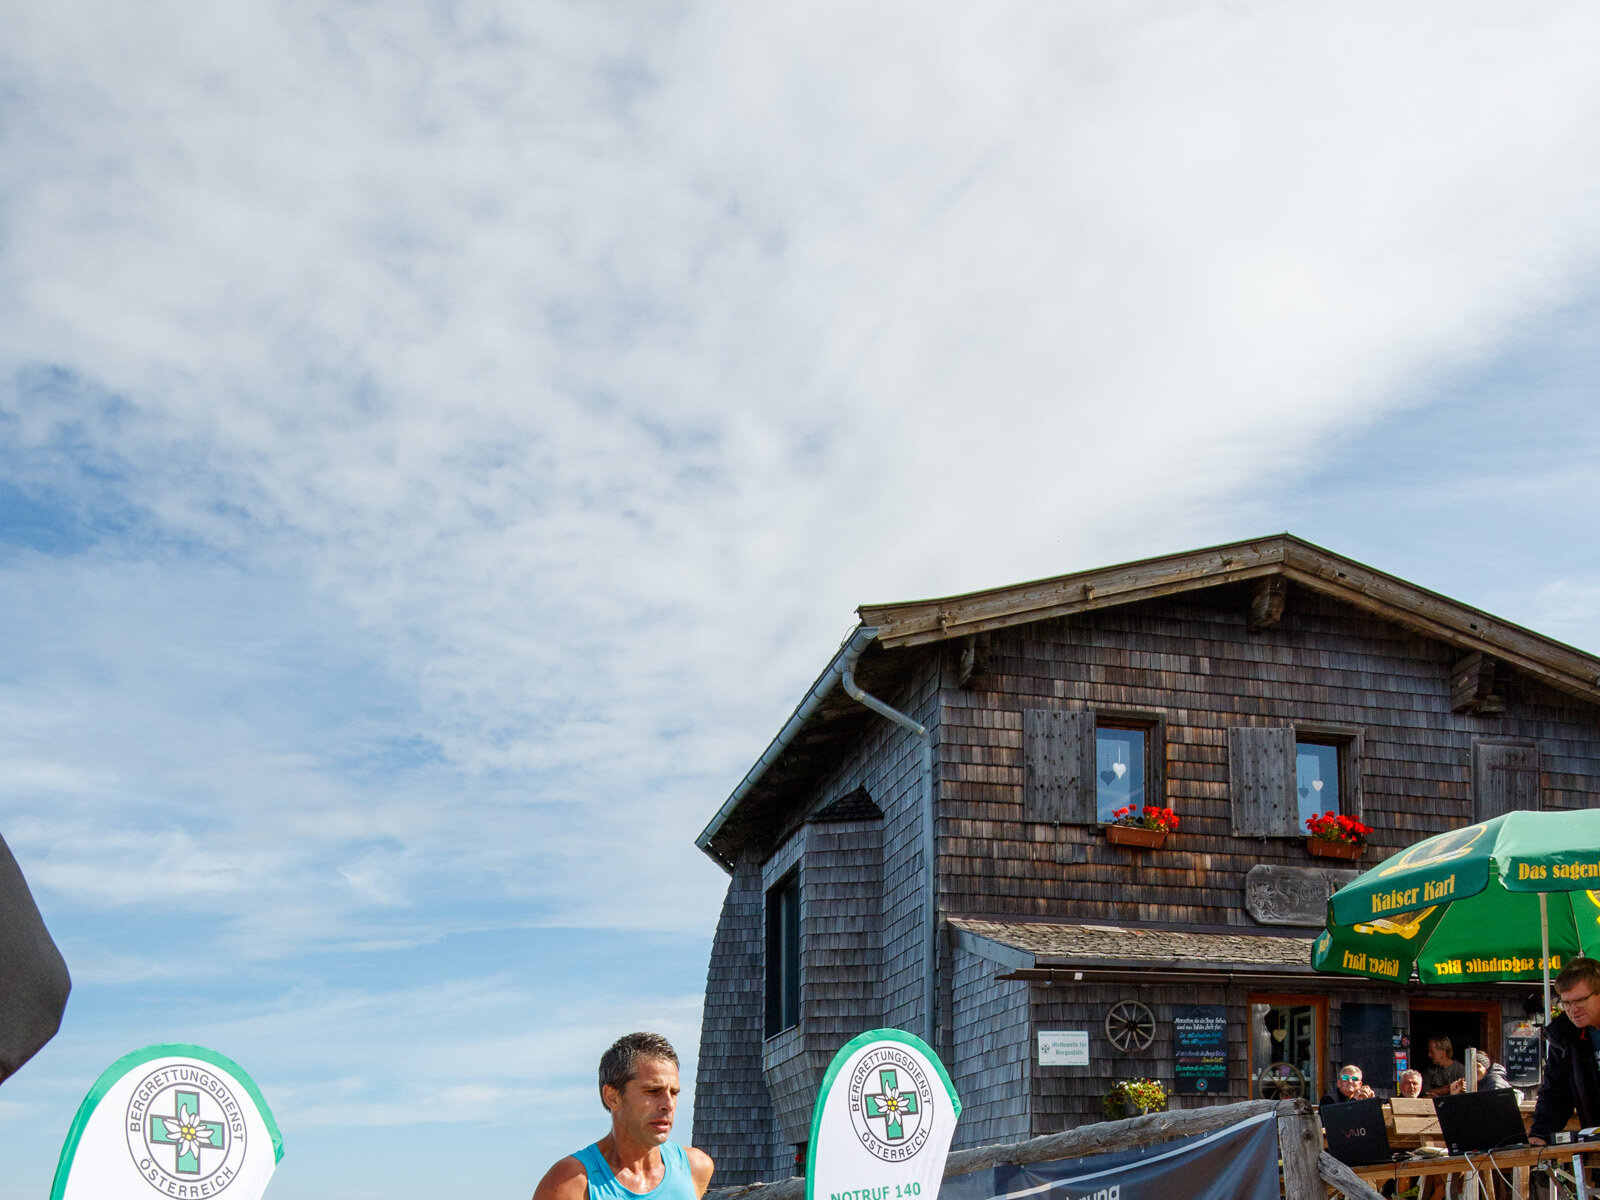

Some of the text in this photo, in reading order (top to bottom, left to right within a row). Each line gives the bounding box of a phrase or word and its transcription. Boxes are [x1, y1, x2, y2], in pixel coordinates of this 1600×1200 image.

[1519, 861, 1600, 880] Das sagen
[1371, 874, 1456, 913] Kaiser Karl
[851, 1050, 932, 1112] BERGRETTUNGSDIENST
[130, 1069, 244, 1143] BERGRETTUNGSDIENST
[862, 1128, 927, 1160] ÖSTERREICH
[1343, 1127, 1366, 1138] VAIO
[140, 1157, 234, 1198] ÖSTERREICH
[896, 1181, 922, 1199] 140
